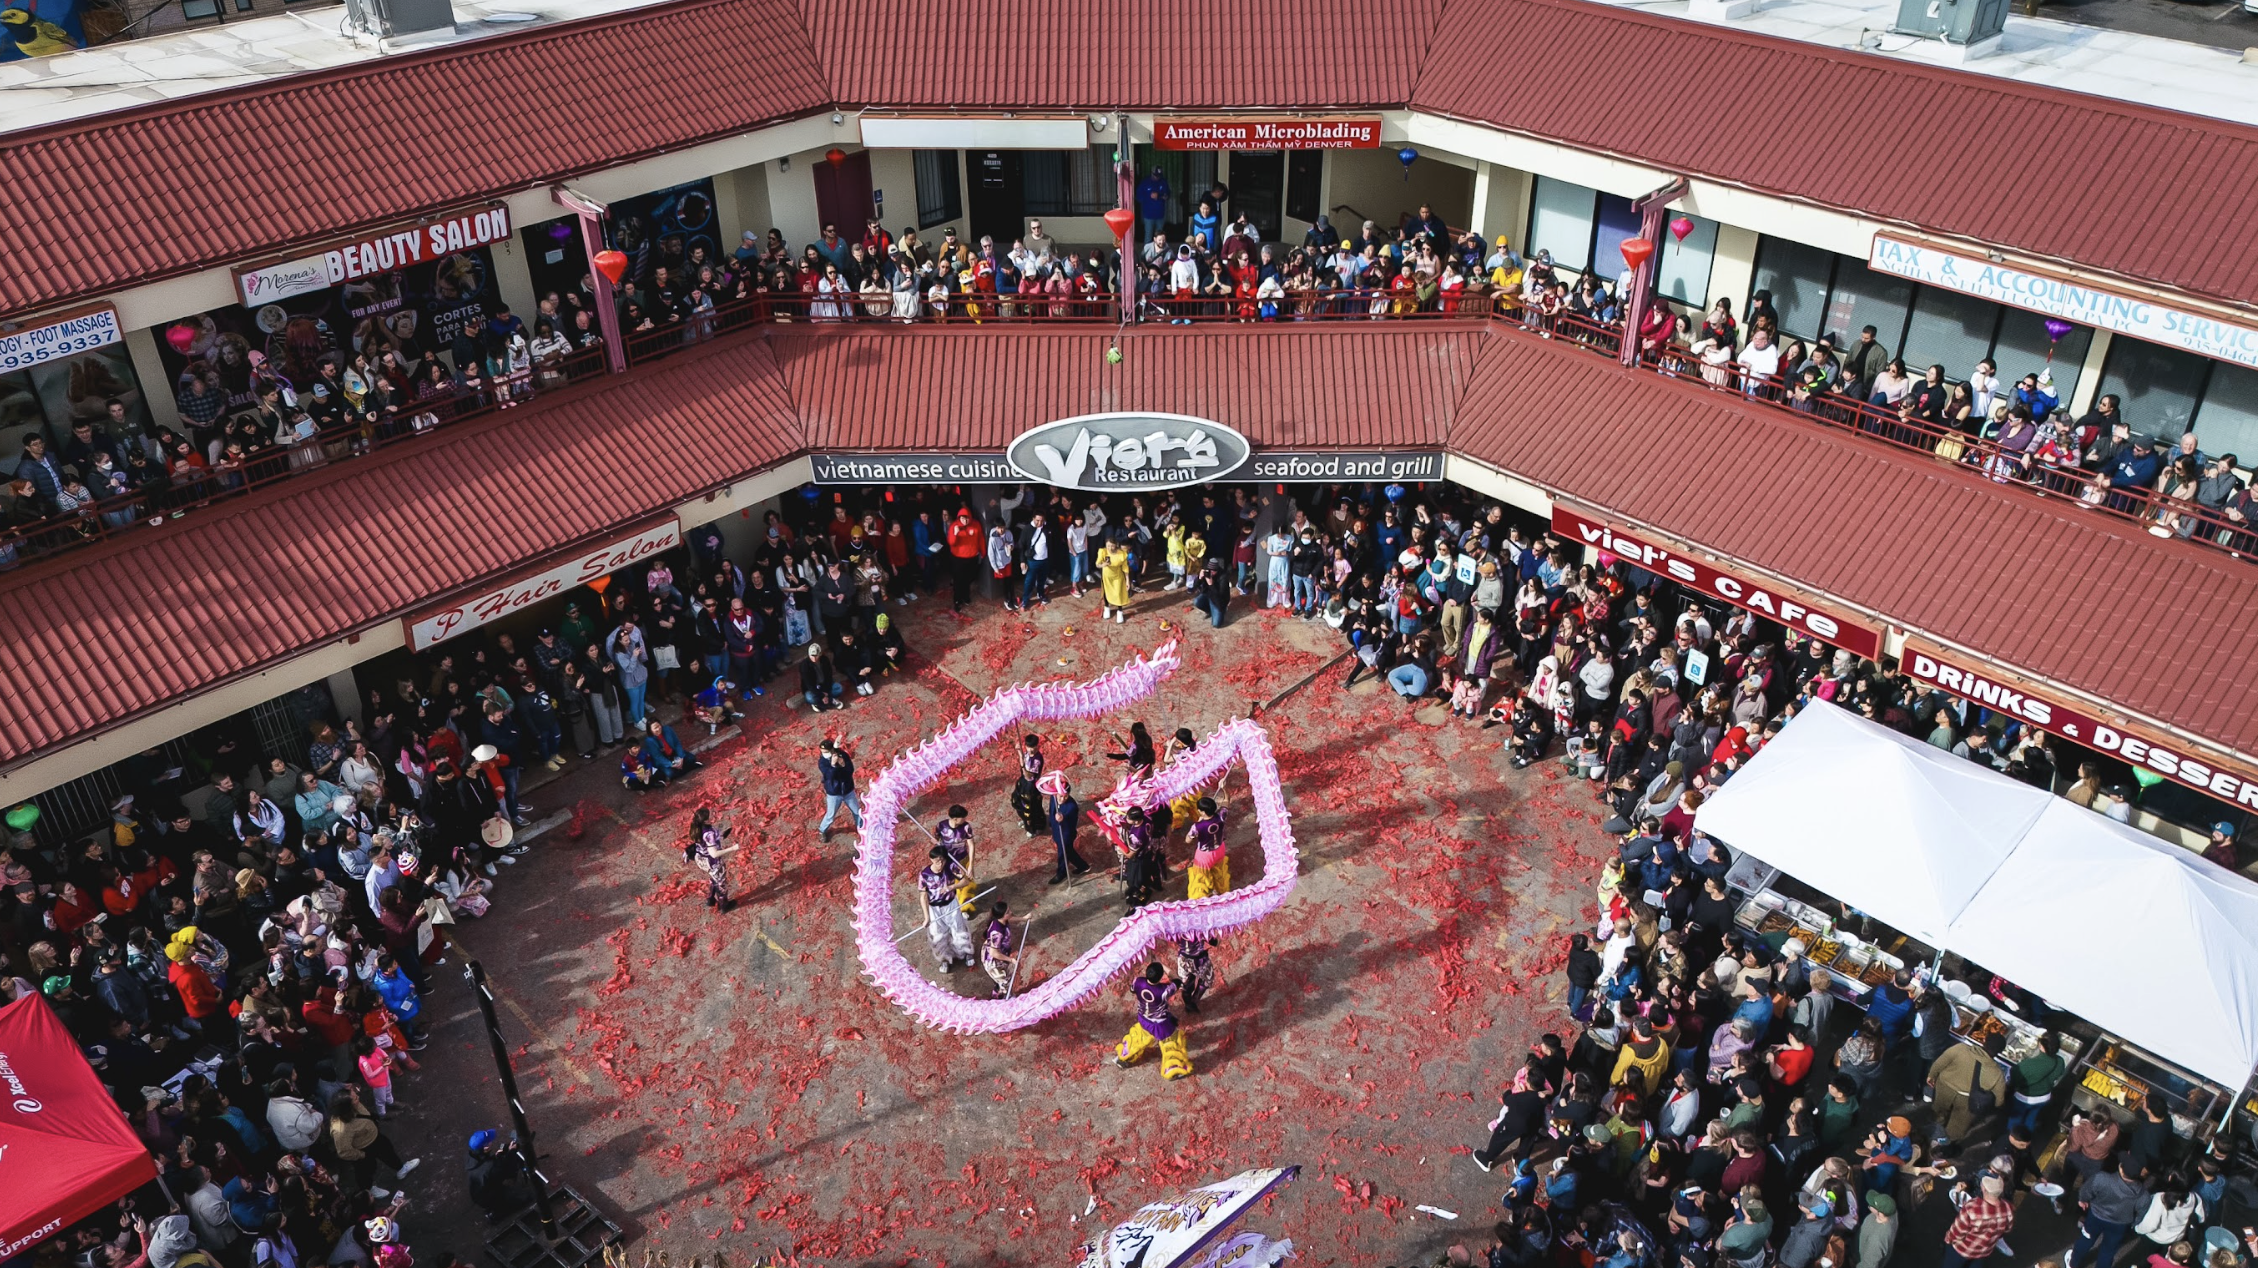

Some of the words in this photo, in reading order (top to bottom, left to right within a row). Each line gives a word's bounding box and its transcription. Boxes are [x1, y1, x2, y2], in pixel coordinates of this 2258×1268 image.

[1165, 124, 1246, 139] American
[1255, 123, 1371, 141] Microblading
[1187, 141, 1219, 149] PHUN
[1305, 140, 1353, 148] DENVER
[324, 229, 421, 284] BEAUTY
[428, 208, 508, 255] SALON
[382, 297, 402, 310] EVENT
[1878, 238, 1923, 267] TAX
[1941, 255, 1958, 277] &
[1978, 266, 2151, 324] ACCOUNTING
[2162, 311, 2258, 352] SERVIC
[433, 303, 481, 325] CORTES
[0, 335, 22, 355] OGY
[30, 326, 58, 346] FOOT
[61, 312, 113, 338] MASSAGE
[436, 322, 461, 335] PARA
[817, 460, 943, 479] vietnamese
[1095, 466, 1198, 483] Restaurant
[1254, 456, 1339, 477] seafood
[1344, 455, 1386, 476] and
[1391, 456, 1433, 480] grill
[473, 578, 563, 621] Hair
[577, 532, 674, 583] Salon
[2062, 722, 2080, 738] &
[0, 1217, 62, 1258] UPPORT
